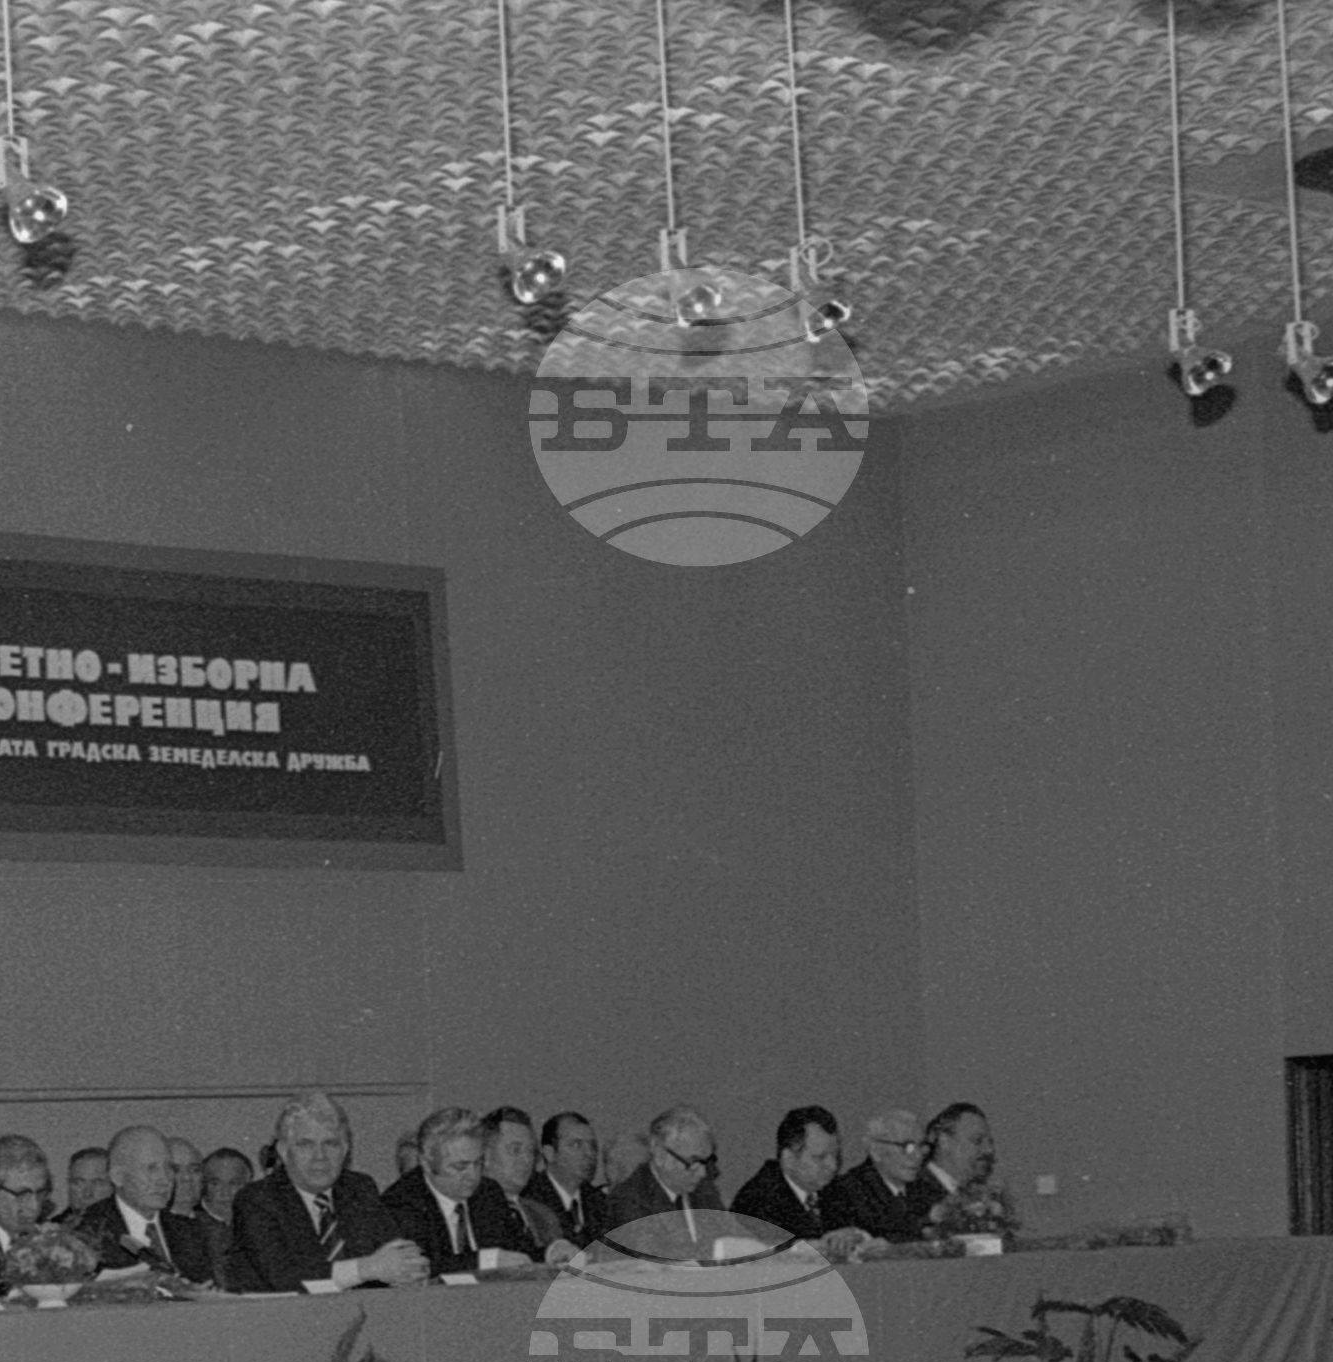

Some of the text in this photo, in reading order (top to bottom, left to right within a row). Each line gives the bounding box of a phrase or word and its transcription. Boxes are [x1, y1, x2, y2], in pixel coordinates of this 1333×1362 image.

[46, 740, 142, 763] ГРАДСКА
[148, 744, 281, 770] ЗЕМЕДЕЛСКА
[286, 752, 372, 773] ДРУЖБА
